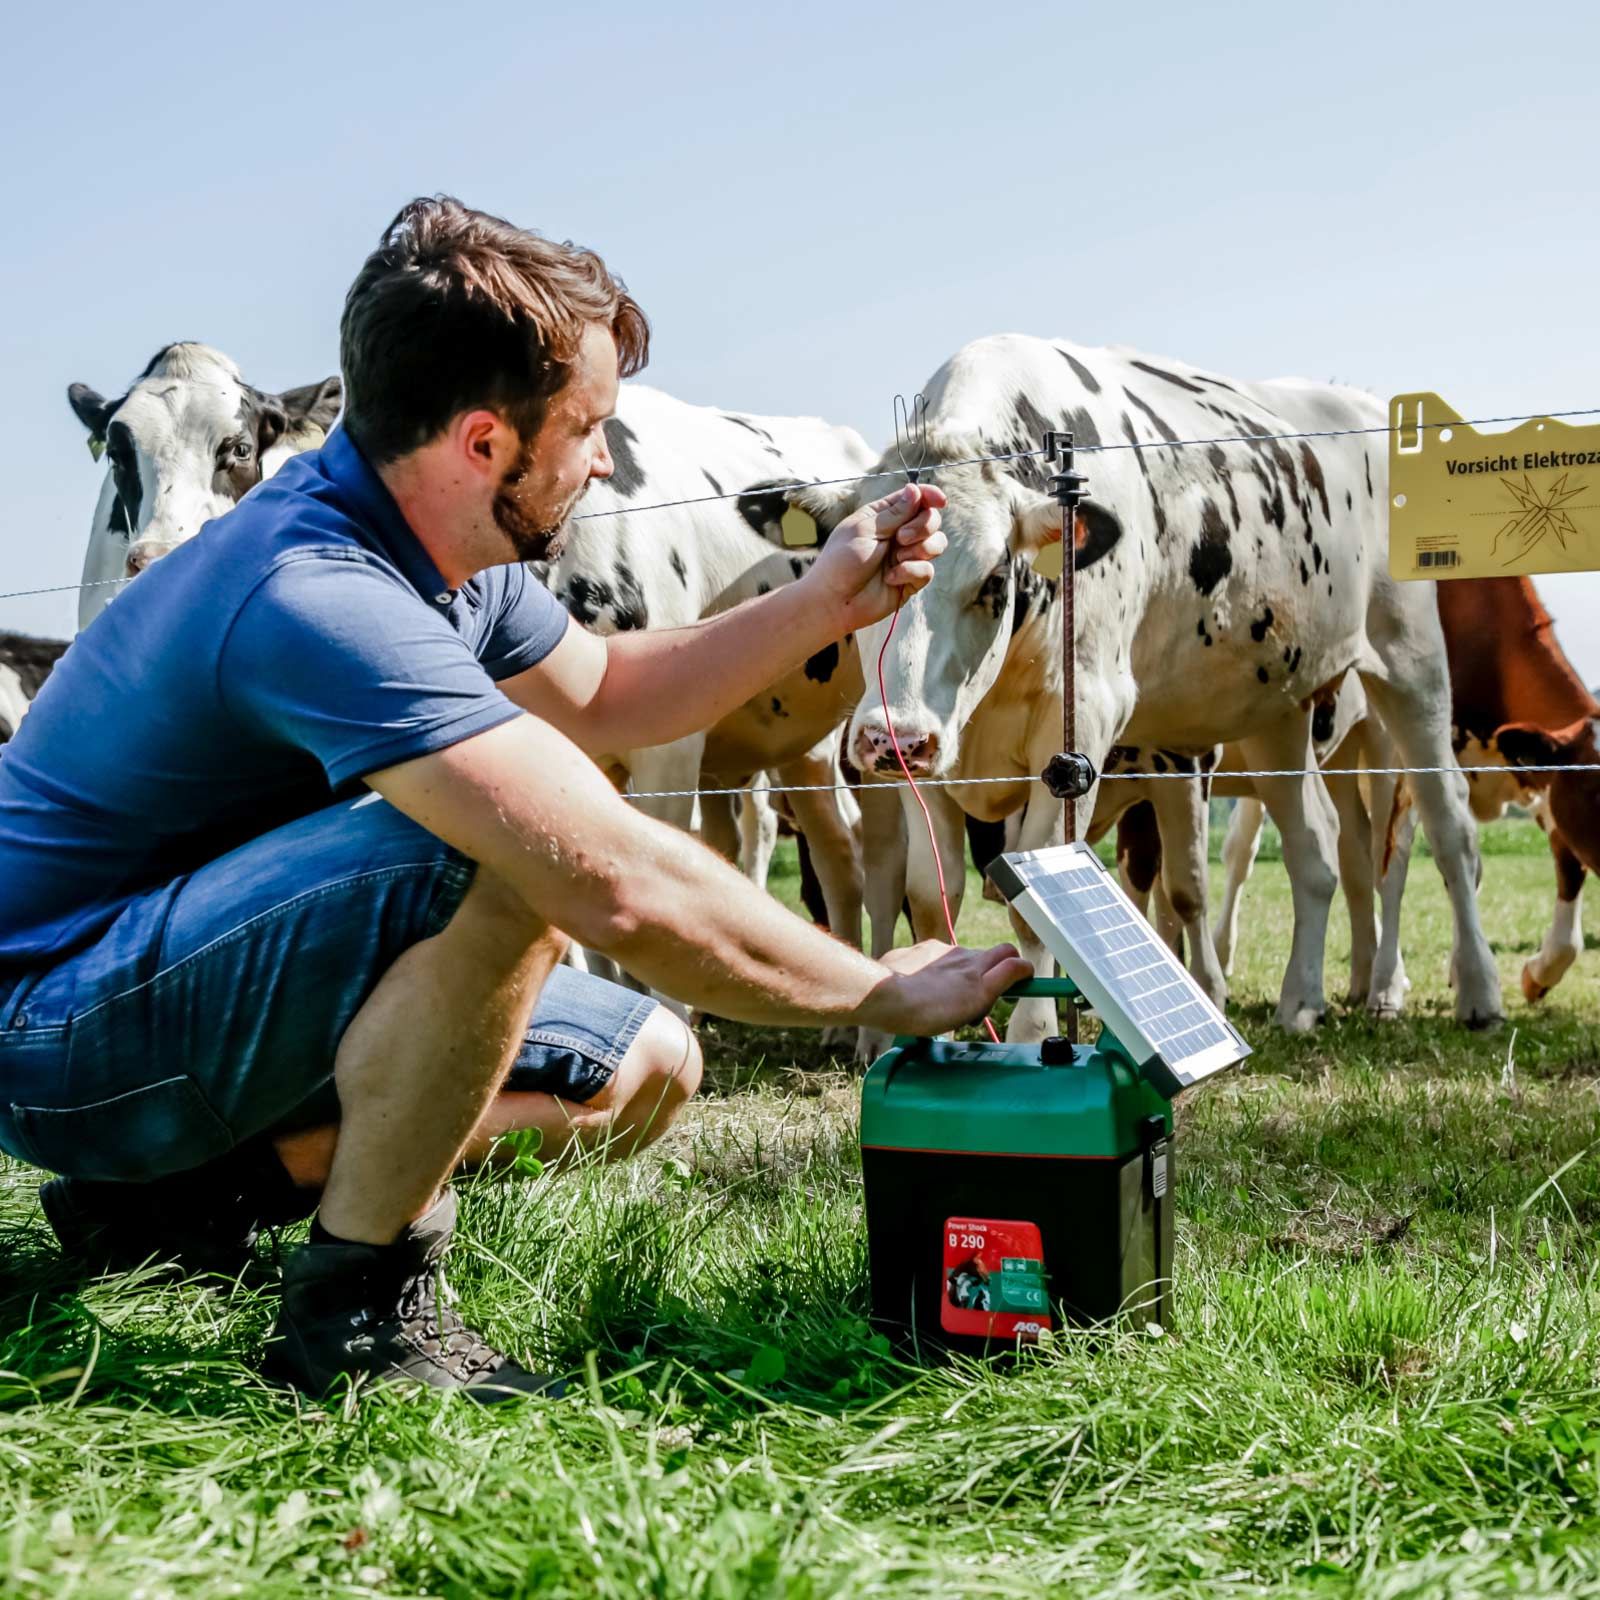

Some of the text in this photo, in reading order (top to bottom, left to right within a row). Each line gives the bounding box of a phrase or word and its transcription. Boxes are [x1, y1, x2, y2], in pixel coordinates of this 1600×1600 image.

[1446, 456, 1517, 475] Vorsicht
[949, 1233, 985, 1249] B 290
